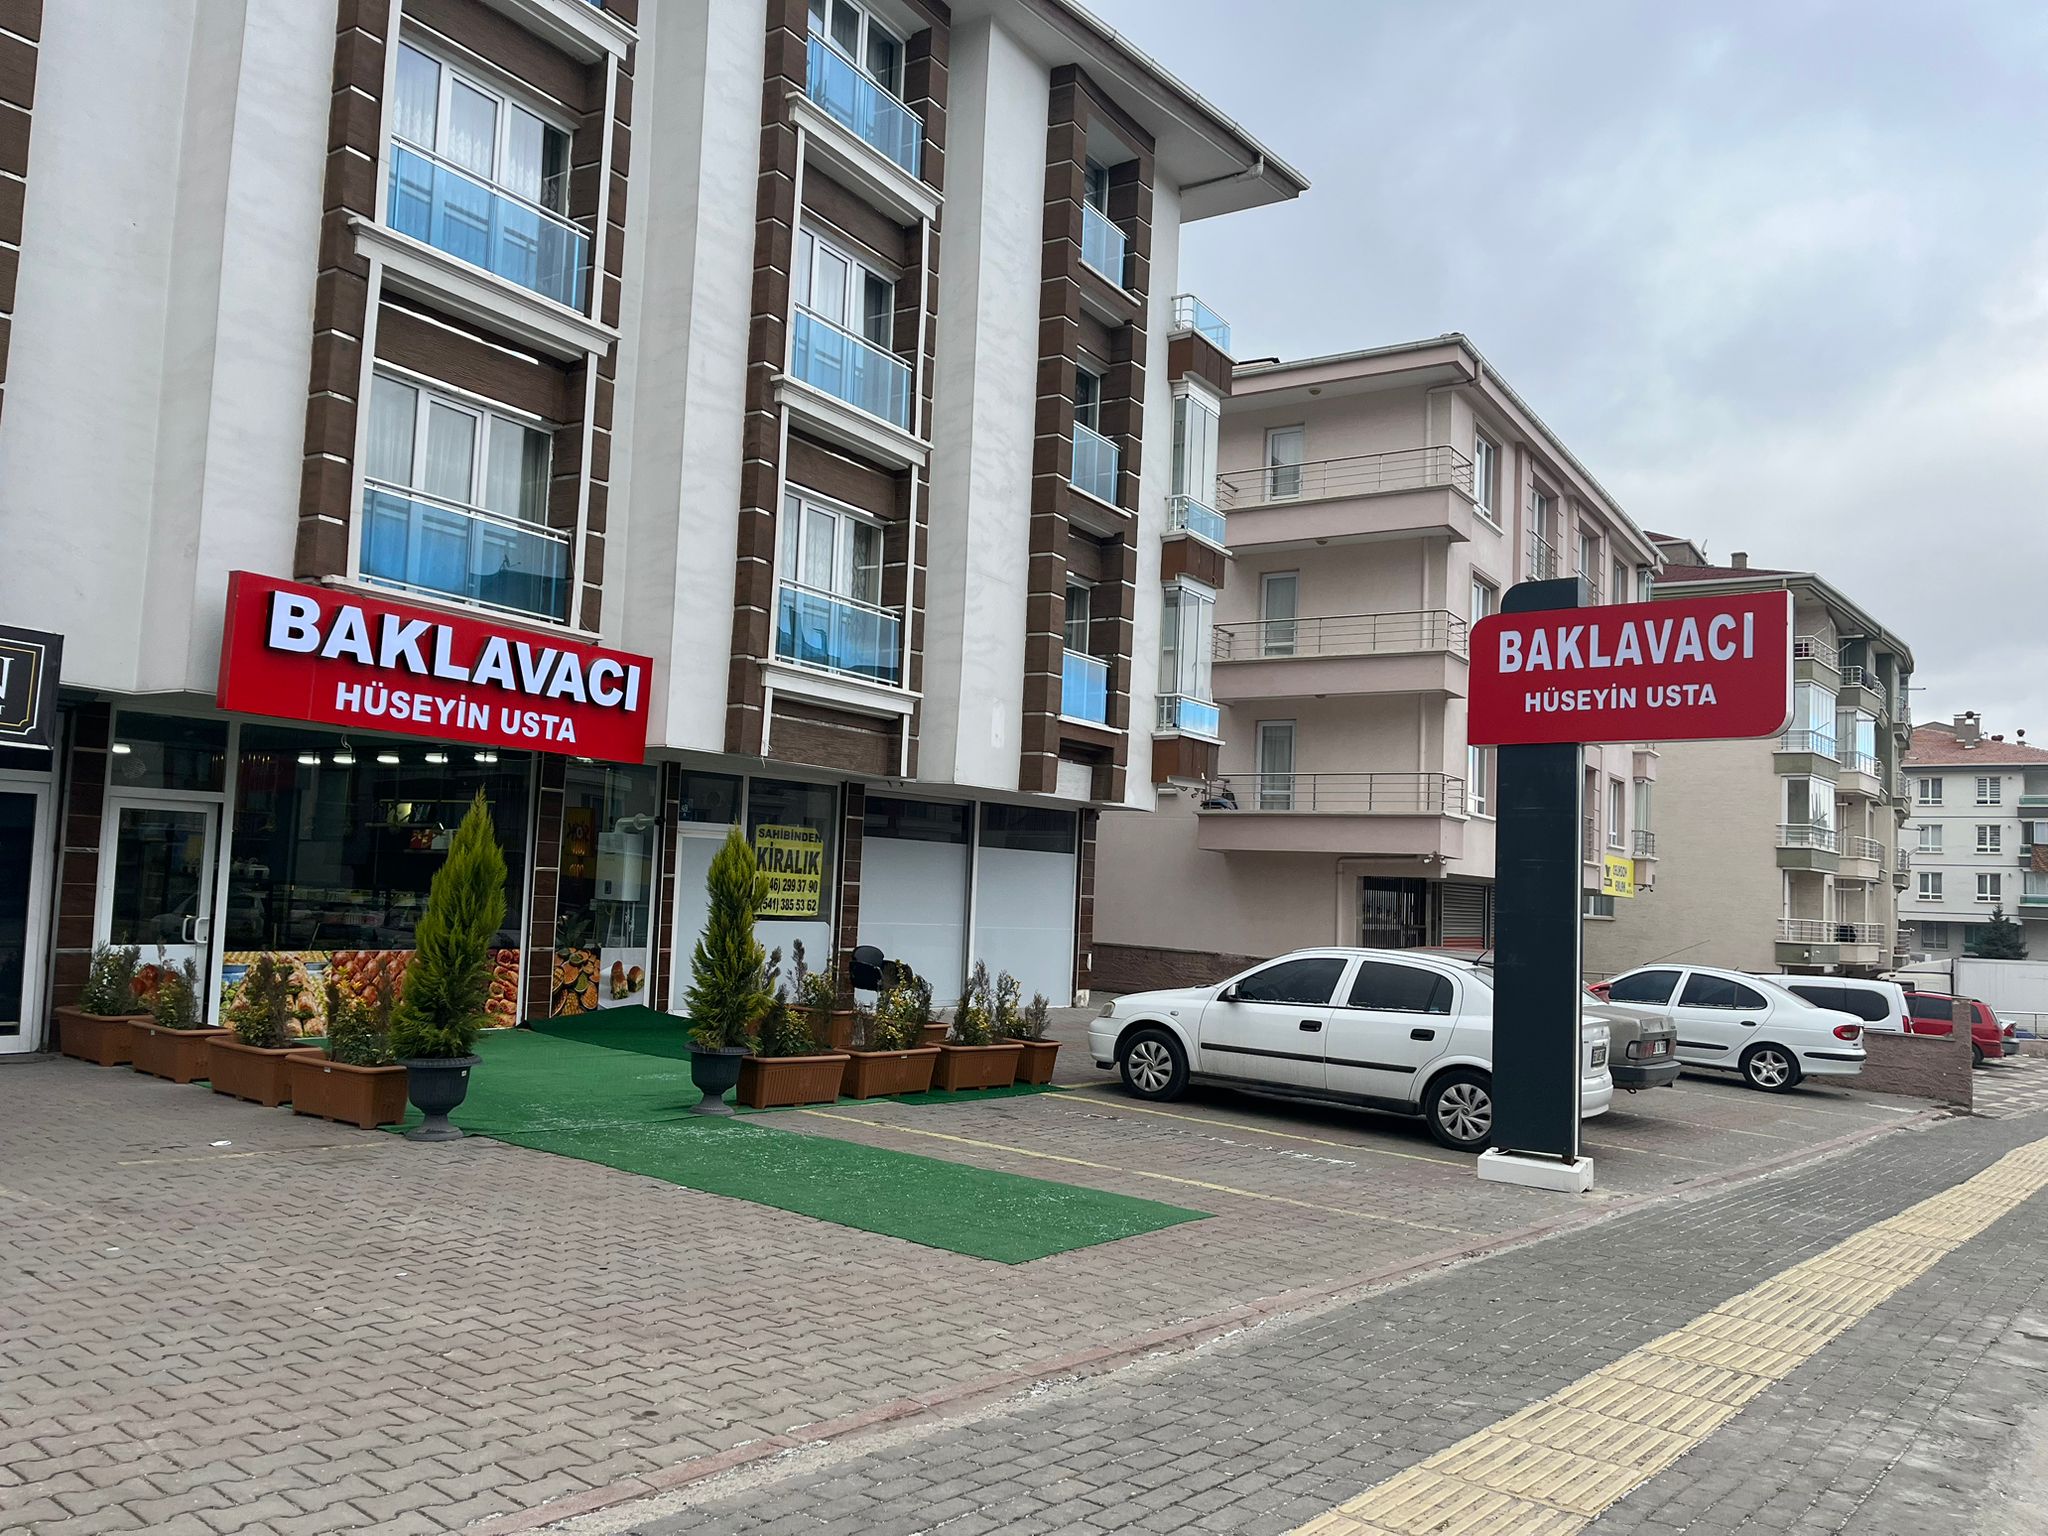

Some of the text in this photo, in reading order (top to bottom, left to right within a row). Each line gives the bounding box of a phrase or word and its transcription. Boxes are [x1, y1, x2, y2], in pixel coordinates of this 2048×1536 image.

[268, 590, 641, 712] BAKLAVACI
[1498, 611, 1755, 674] BAKLAVACI
[335, 680, 577, 743] HÜSEYİN USTA
[1525, 681, 1717, 713] HÜSEYİN USTA
[758, 828, 822, 843] SAHİBİNDEN
[756, 841, 820, 875] KİRALIK
[782, 878, 796, 892] 299
[797, 878, 807, 892] 37
[806, 899, 817, 911] 62
